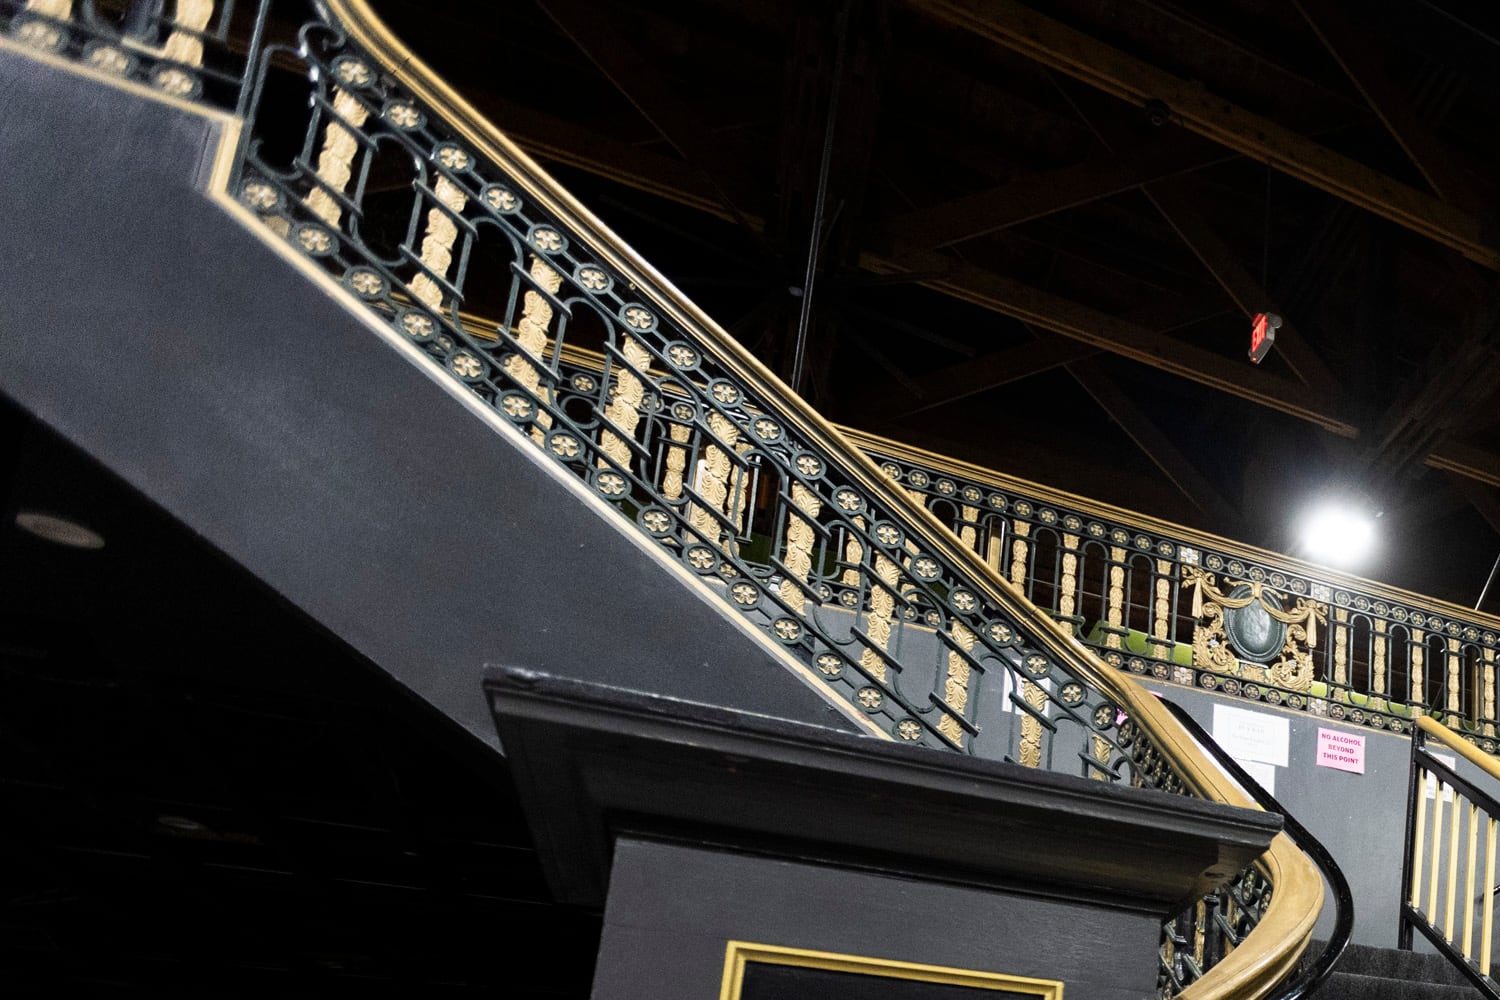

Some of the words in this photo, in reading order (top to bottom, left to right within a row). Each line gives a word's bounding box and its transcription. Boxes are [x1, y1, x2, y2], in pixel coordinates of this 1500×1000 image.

[1332, 735, 1361, 746] ALCOHOL
[1328, 743, 1354, 754] BEYOND
[1323, 752, 1338, 760] THIS
[1338, 755, 1359, 764] POINT
